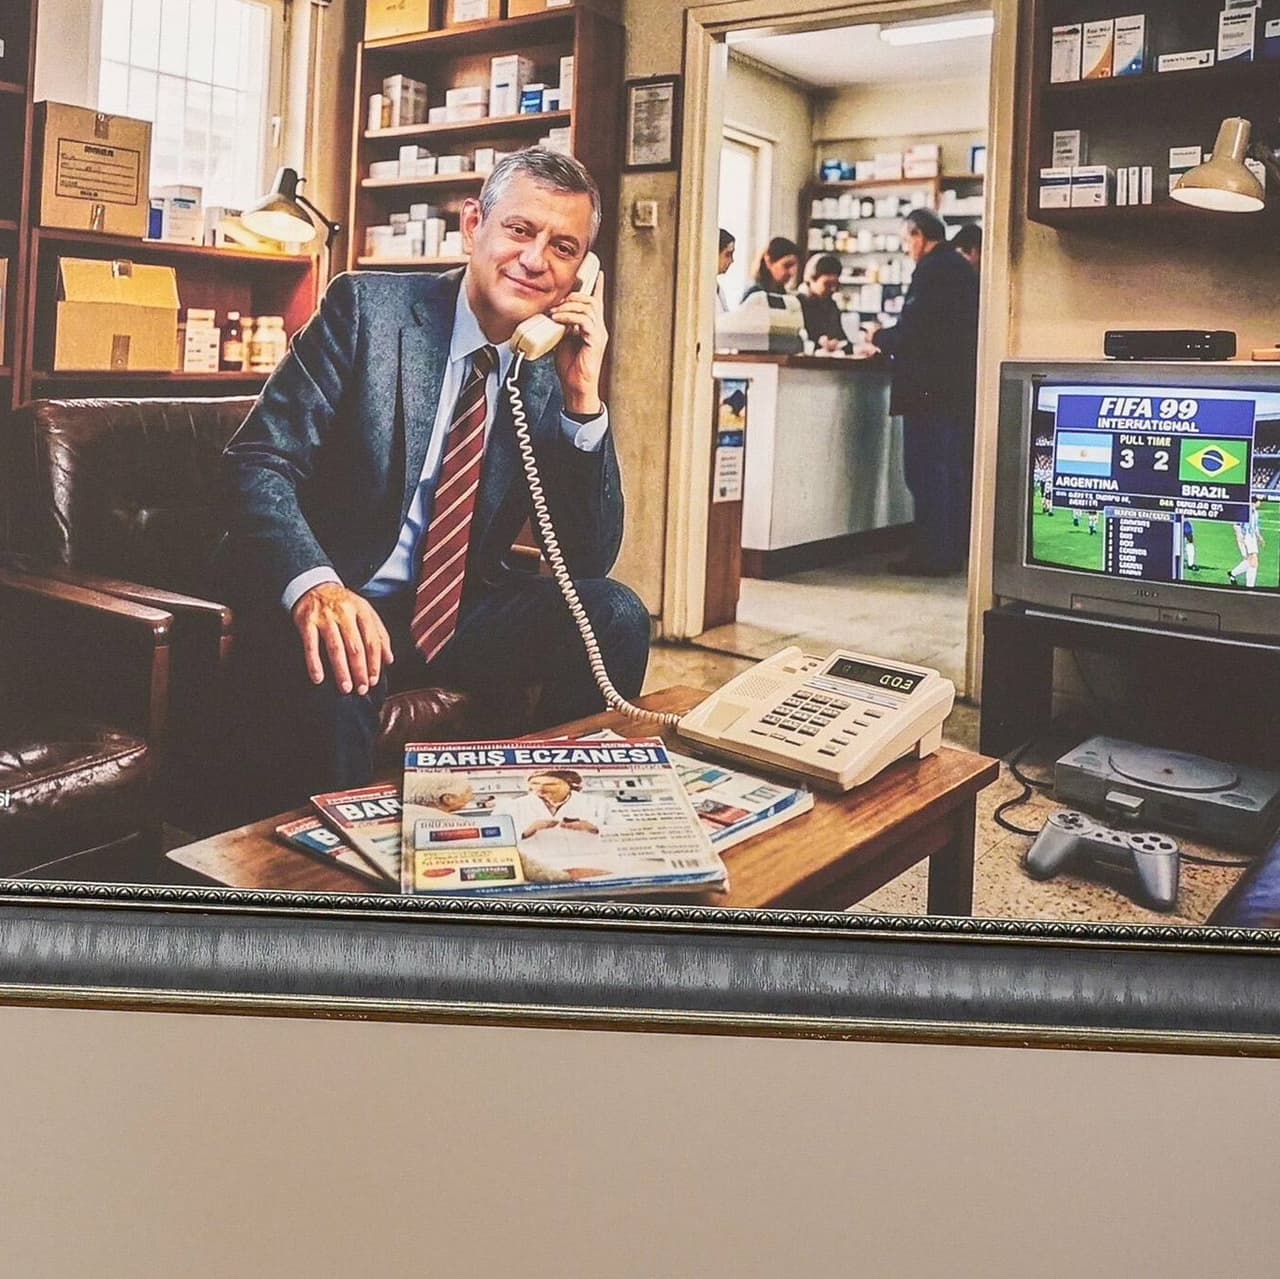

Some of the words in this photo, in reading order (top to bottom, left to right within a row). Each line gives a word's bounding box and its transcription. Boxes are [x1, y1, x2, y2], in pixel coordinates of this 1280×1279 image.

[1099, 397, 1153, 416] FIFA
[1160, 399, 1199, 419] 99
[1120, 448, 1135, 469] 3
[1153, 451, 1169, 470] 2
[1055, 476, 1119, 491] ARGENTINA
[1182, 485, 1230, 500] BRAZIL
[417, 751, 506, 768] BARIŞ
